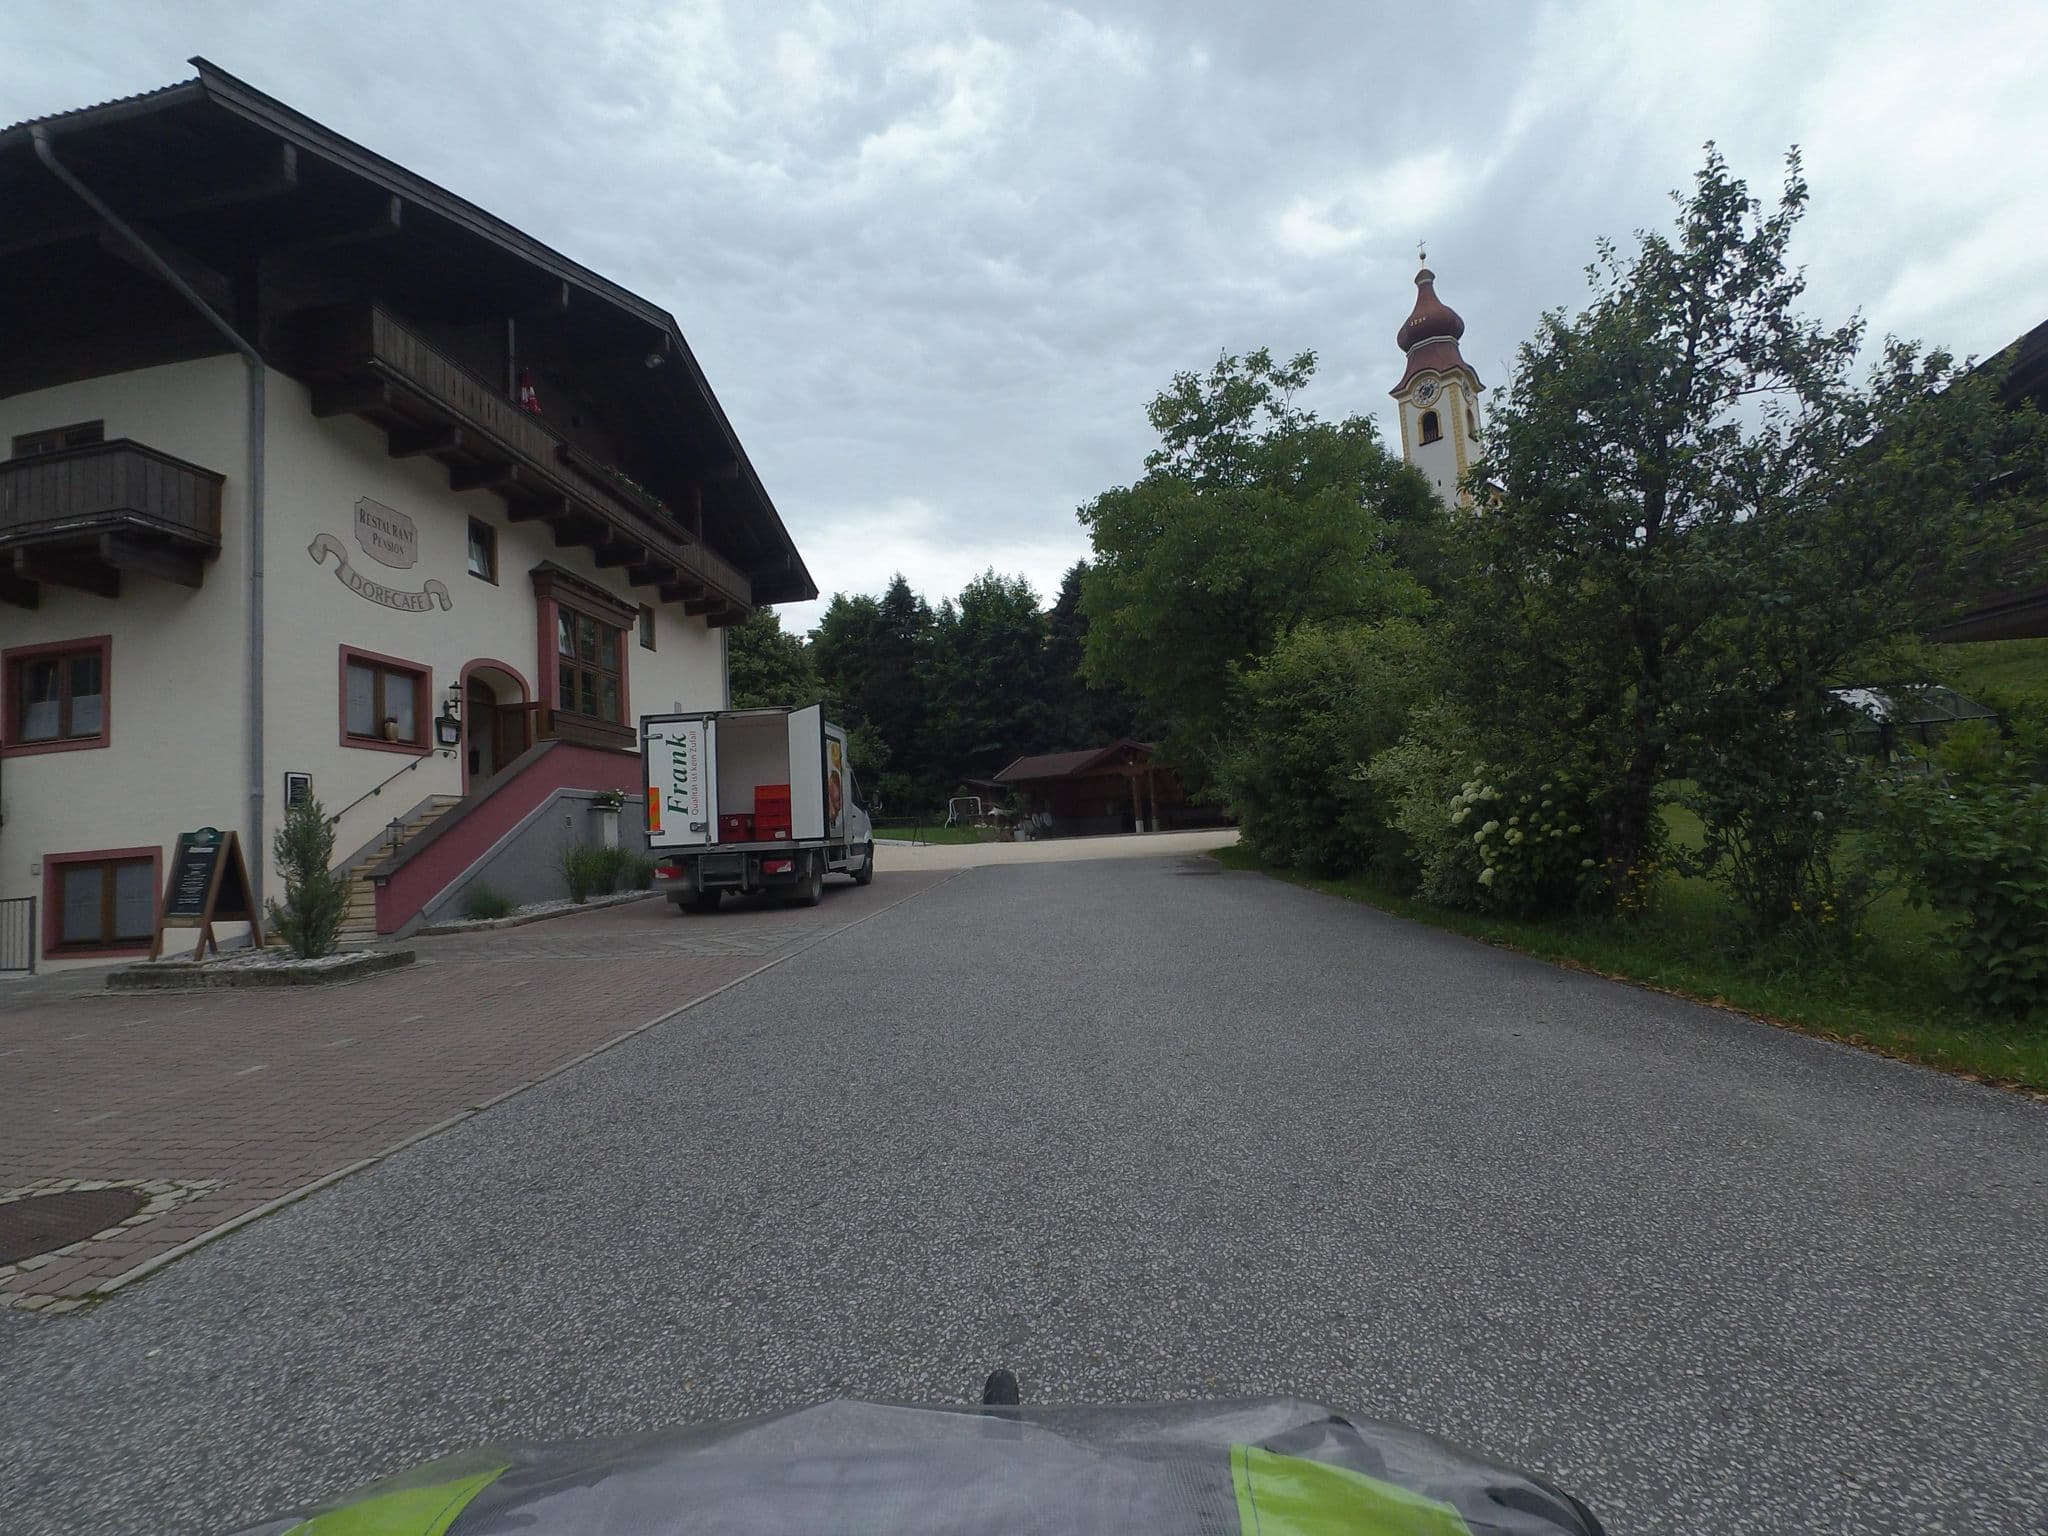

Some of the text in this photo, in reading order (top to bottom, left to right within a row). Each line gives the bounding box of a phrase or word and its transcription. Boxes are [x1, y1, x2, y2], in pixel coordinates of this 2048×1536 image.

[359, 508, 414, 543] RESTAURANT
[372, 533, 405, 555] PENSION
[690, 731, 698, 752] Zufall
[690, 754, 698, 771] kein
[665, 733, 689, 815] Frank
